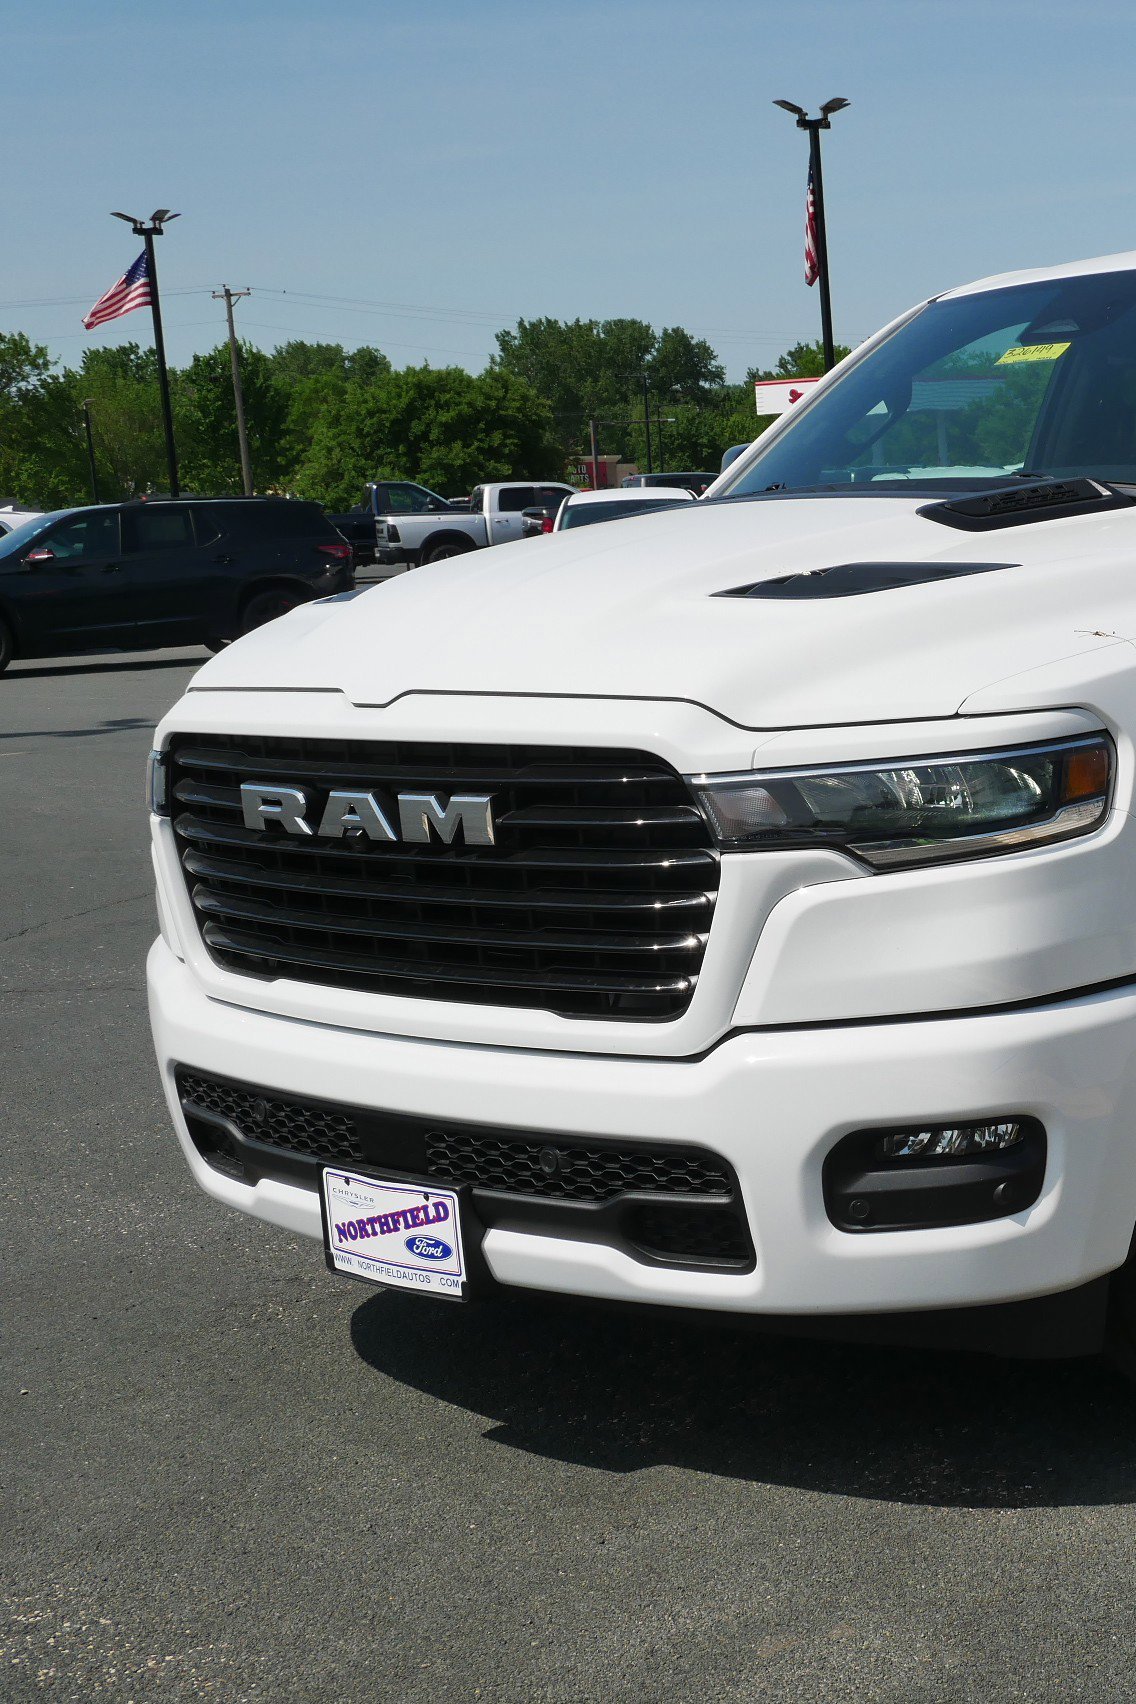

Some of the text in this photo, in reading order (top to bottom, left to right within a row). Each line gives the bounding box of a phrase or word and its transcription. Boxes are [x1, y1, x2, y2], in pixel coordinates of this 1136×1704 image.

[240, 781, 499, 846] RAM
[332, 1187, 375, 1203] CHRYSLER
[334, 1200, 450, 1244] NORTHFIELD
[413, 1237, 444, 1258] Ford
[357, 1260, 431, 1284] NORTHFIELDAUTOS
